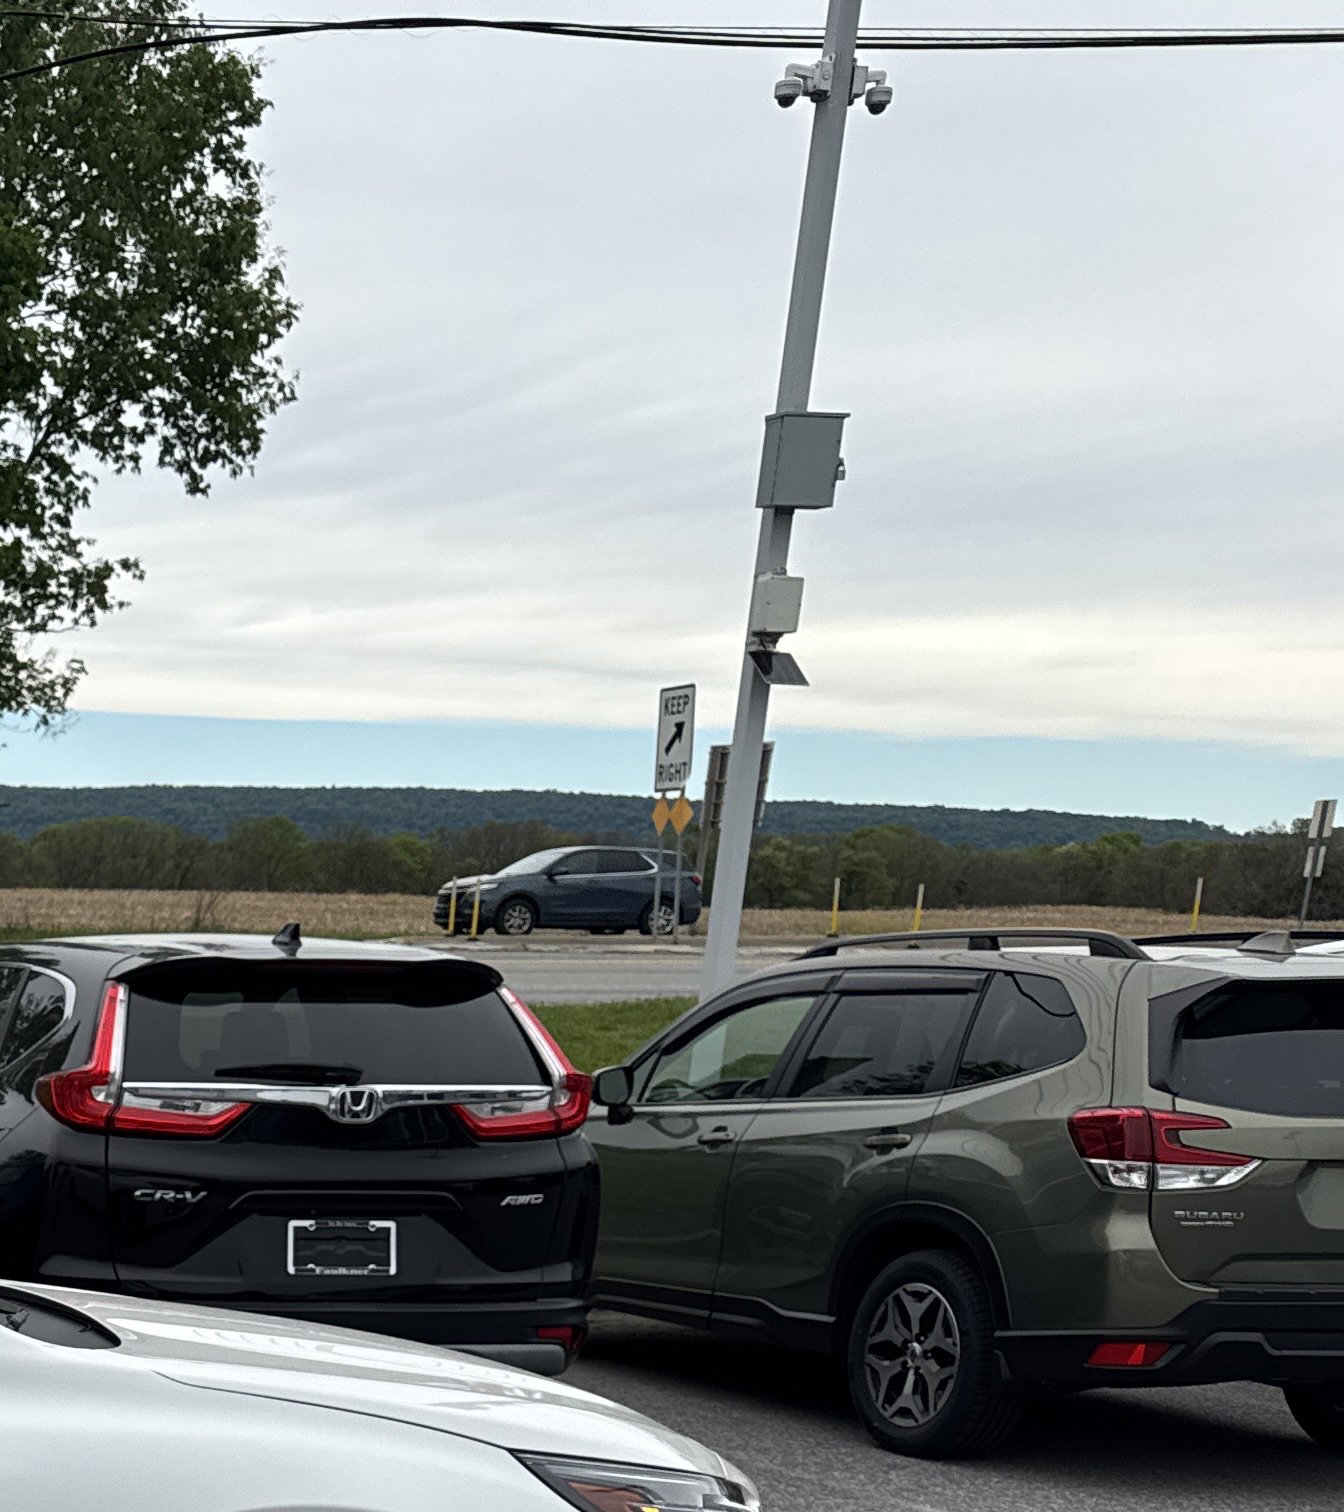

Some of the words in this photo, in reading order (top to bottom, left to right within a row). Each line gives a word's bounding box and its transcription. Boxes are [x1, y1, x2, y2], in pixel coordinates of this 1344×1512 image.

[664, 694, 690, 716] KEEP
[658, 762, 688, 783] RIGHT
[133, 1189, 208, 1203] CR-V
[500, 1193, 545, 1206] AWD
[1174, 1210, 1245, 1220] SUBARU
[315, 1266, 370, 1275] Faulkner
